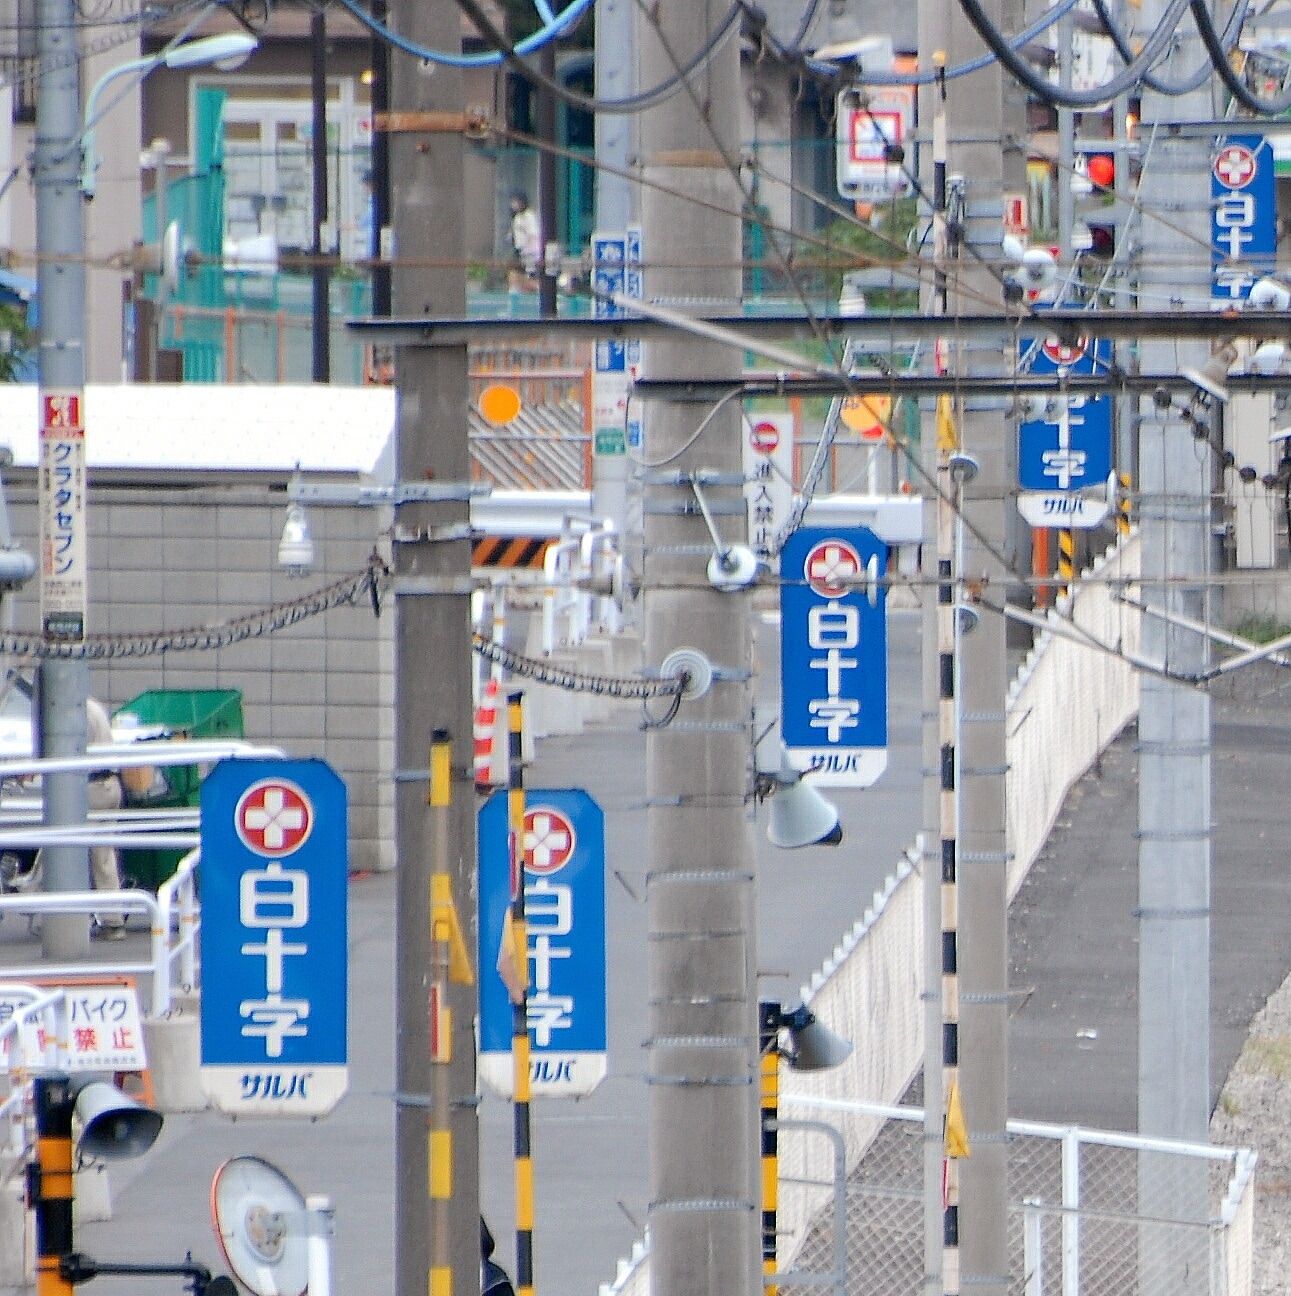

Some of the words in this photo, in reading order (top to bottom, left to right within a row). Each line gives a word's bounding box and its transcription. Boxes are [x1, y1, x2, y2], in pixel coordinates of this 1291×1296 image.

[808, 600, 860, 743] 白十字
[809, 754, 861, 774] サルバ
[239, 862, 311, 1057] 白十字
[524, 876, 573, 1046] 白十字
[71, 998, 127, 1022] バイク
[528, 1060, 577, 1083] ルバ
[241, 1073, 312, 1099] サルバ
